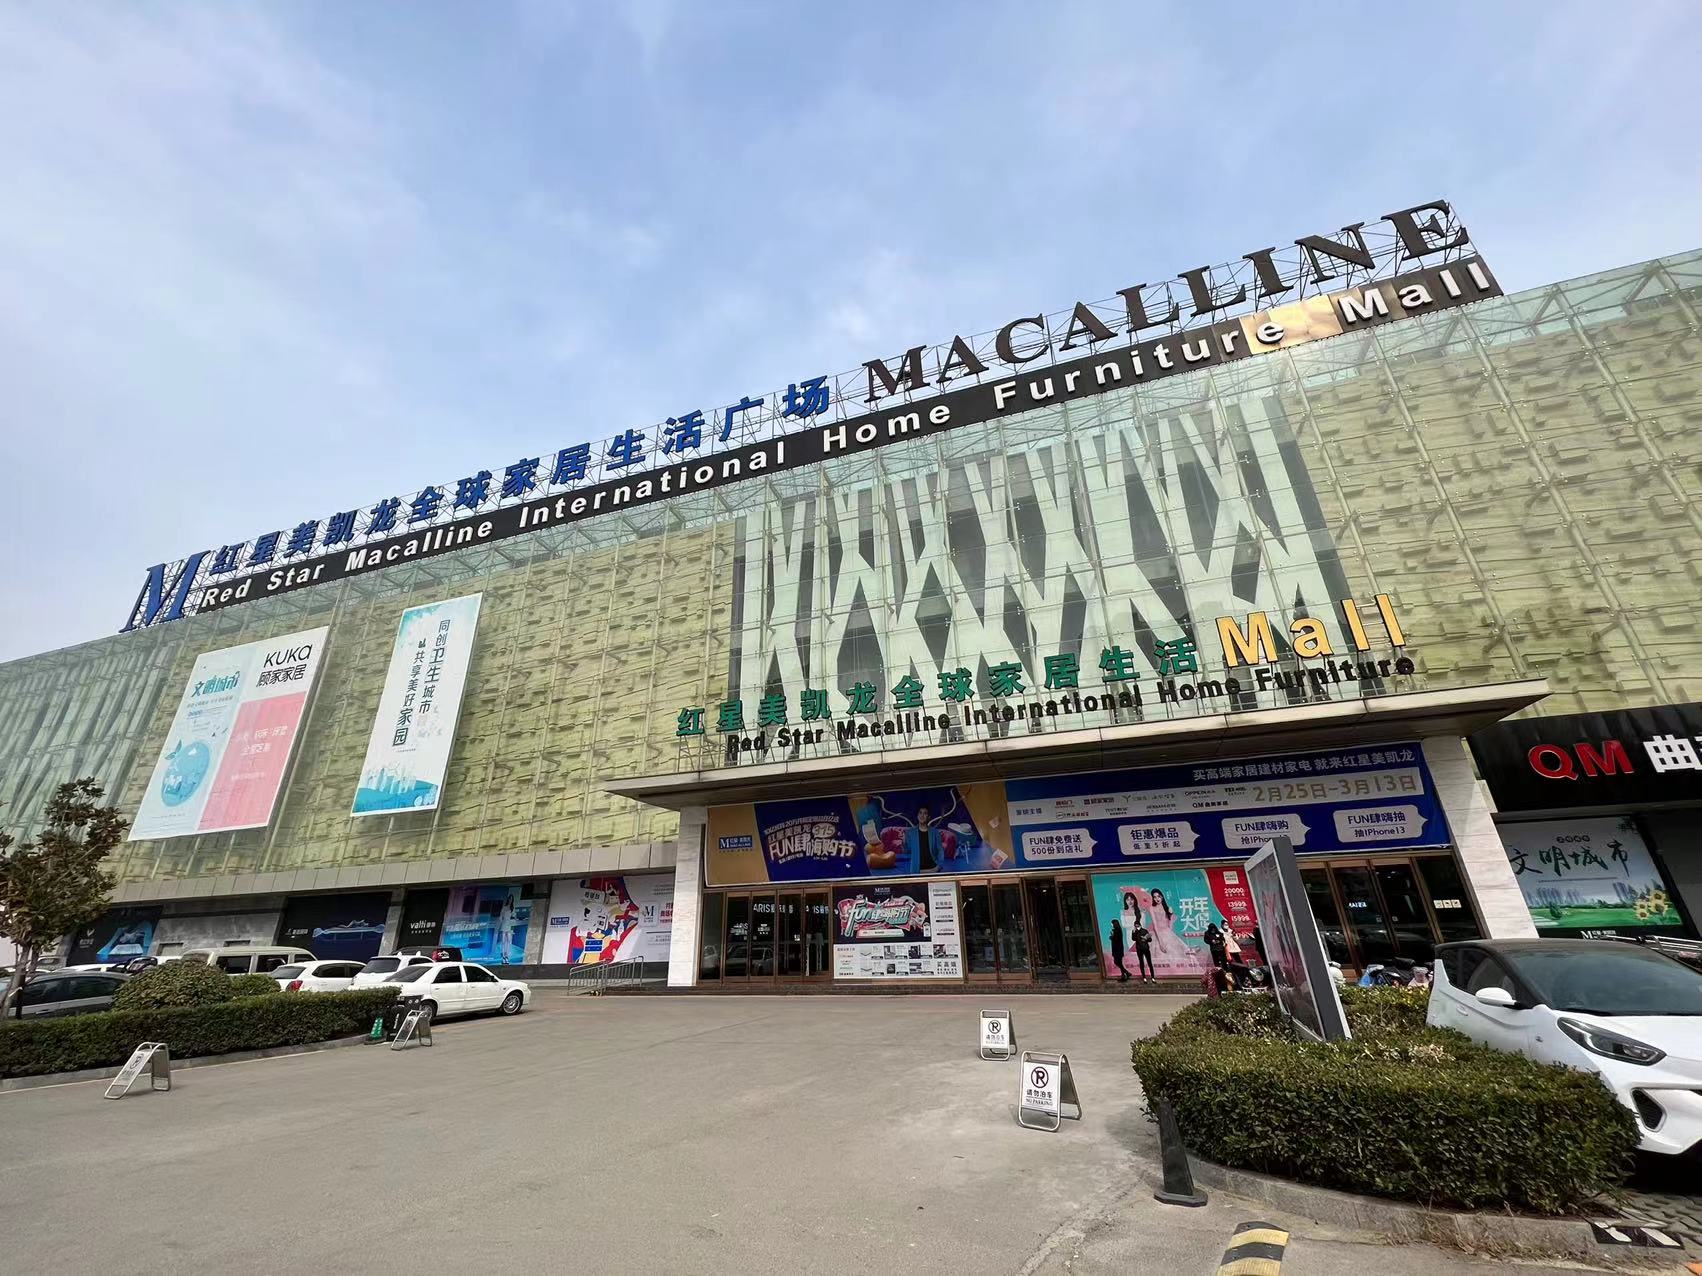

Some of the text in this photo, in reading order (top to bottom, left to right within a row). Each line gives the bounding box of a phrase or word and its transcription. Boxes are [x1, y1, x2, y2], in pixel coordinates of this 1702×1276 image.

[861, 199, 1470, 403] MACALLINE
[201, 262, 1491, 608] Red Star Macalline International Home Furniture Mall
[208, 375, 830, 576] 红星美凯龙全球家居生活广场
[118, 549, 211, 631] M
[1215, 593, 1407, 668] Mall
[190, 671, 241, 698] 文明城市
[255, 664, 307, 688] 顾家家居
[418, 619, 451, 714] 同创卫生城市
[391, 650, 426, 747] 共享美好家园
[676, 637, 1199, 737] 红星美凯龙全球家居生活
[727, 655, 1416, 754] Red Star Macalline International Home Furniture
[1192, 749, 1415, 781] 买高端家居建材家电 就来红星美凯龙
[1528, 734, 1702, 781] QM 曲
[1251, 775, 1418, 803] 2月25日-3月13日
[1029, 833, 1083, 846] FUN肆免费送
[1031, 843, 1084, 856] 500份到店礼
[1130, 827, 1179, 841] 钜惠爆品
[1509, 839, 1631, 877] 文明城市
[1179, 896, 1209, 918] 开年
[1580, 930, 1594, 939] M
[1026, 1089, 1053, 1098] 请勿泊车
